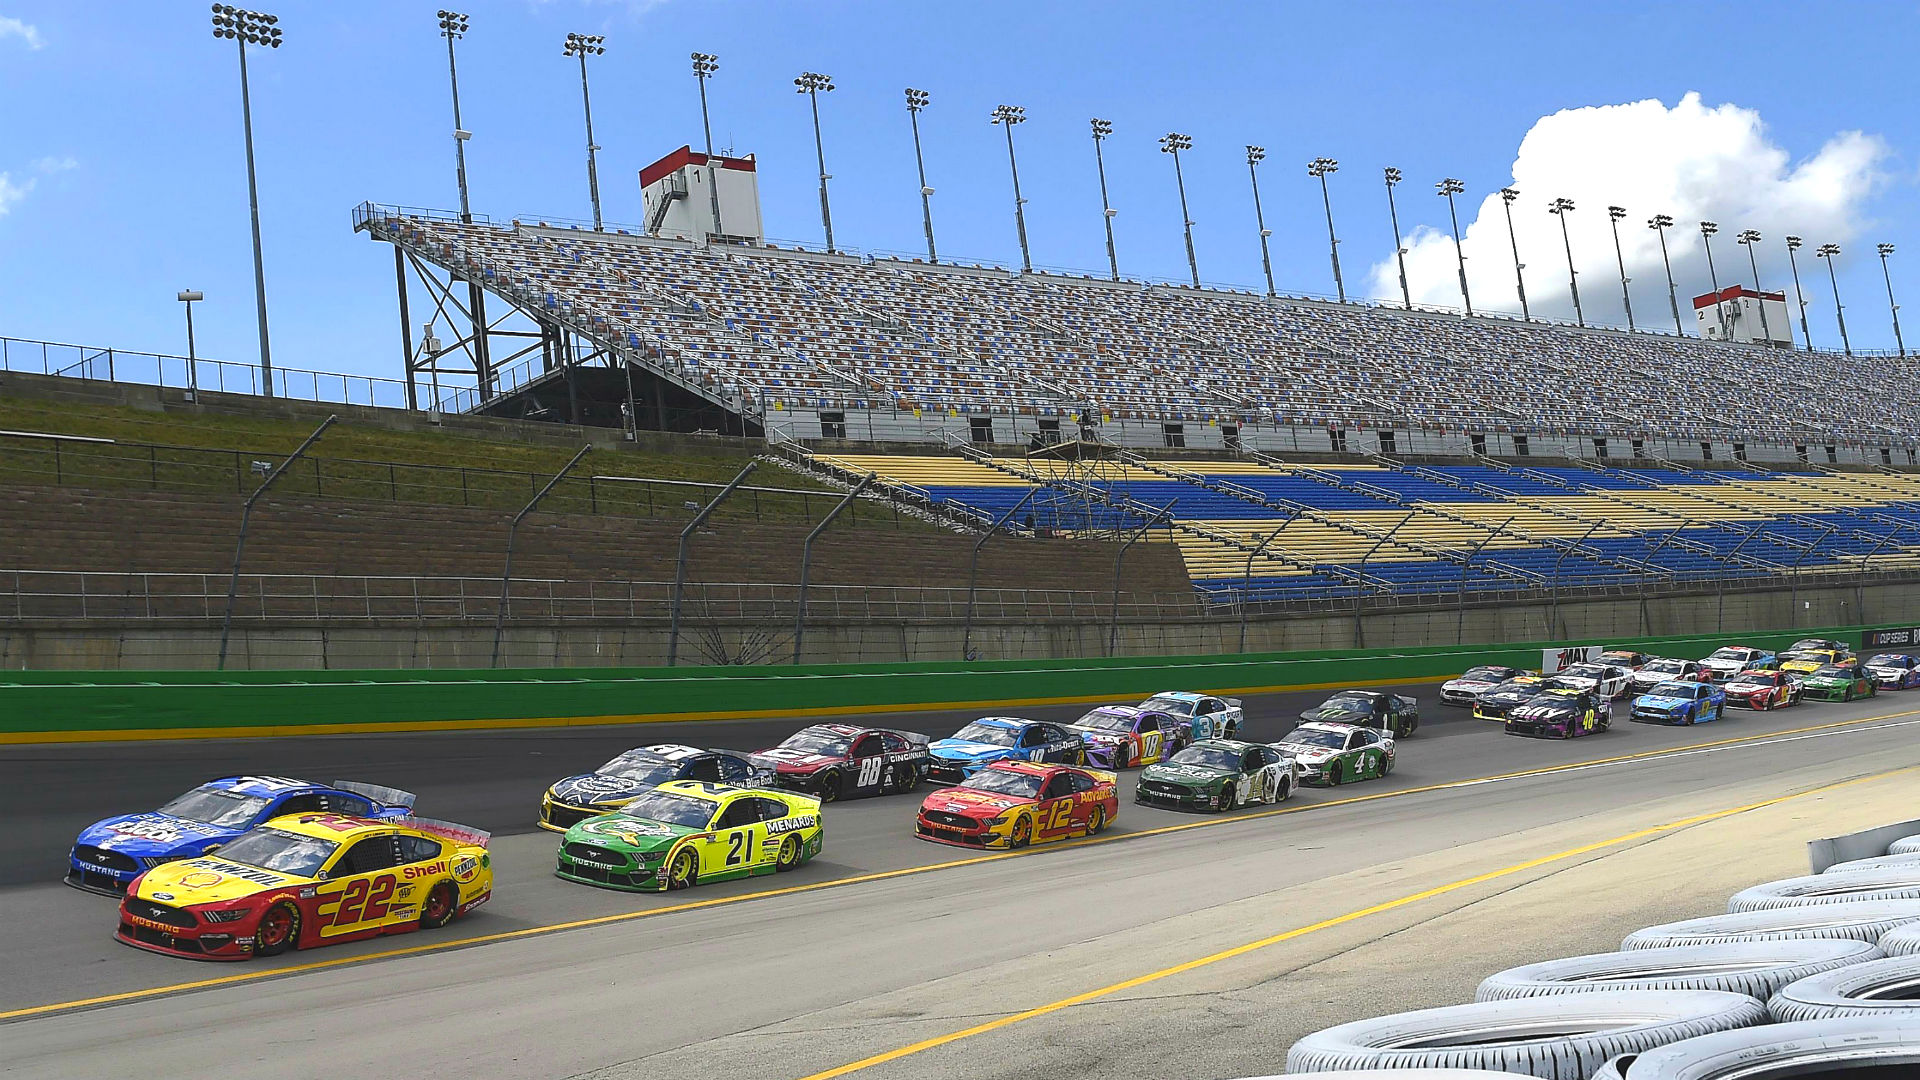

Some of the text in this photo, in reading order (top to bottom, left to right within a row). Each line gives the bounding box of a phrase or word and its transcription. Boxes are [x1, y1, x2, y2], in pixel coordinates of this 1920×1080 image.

[693, 169, 701, 183] 1
[644, 191, 650, 205] 1
[1698, 311, 1705, 320] 2
[1200, 717, 1210, 737] 3
[1582, 709, 1594, 730] 48
[1143, 734, 1159, 758] 18
[890, 750, 926, 763] CINCINNATI
[1354, 752, 1366, 774] 4
[857, 757, 882, 787] 88
[1149, 790, 1181, 799] MUSTANG
[1047, 798, 1074, 829] 12
[766, 815, 815, 835] MENARDS
[726, 829, 754, 866] 21
[79, 861, 121, 877] MUSTANG
[403, 861, 446, 880] Shell
[571, 856, 613, 870] MUSTANG
[333, 873, 397, 926] 22
[131, 915, 180, 934] MUSTANG
